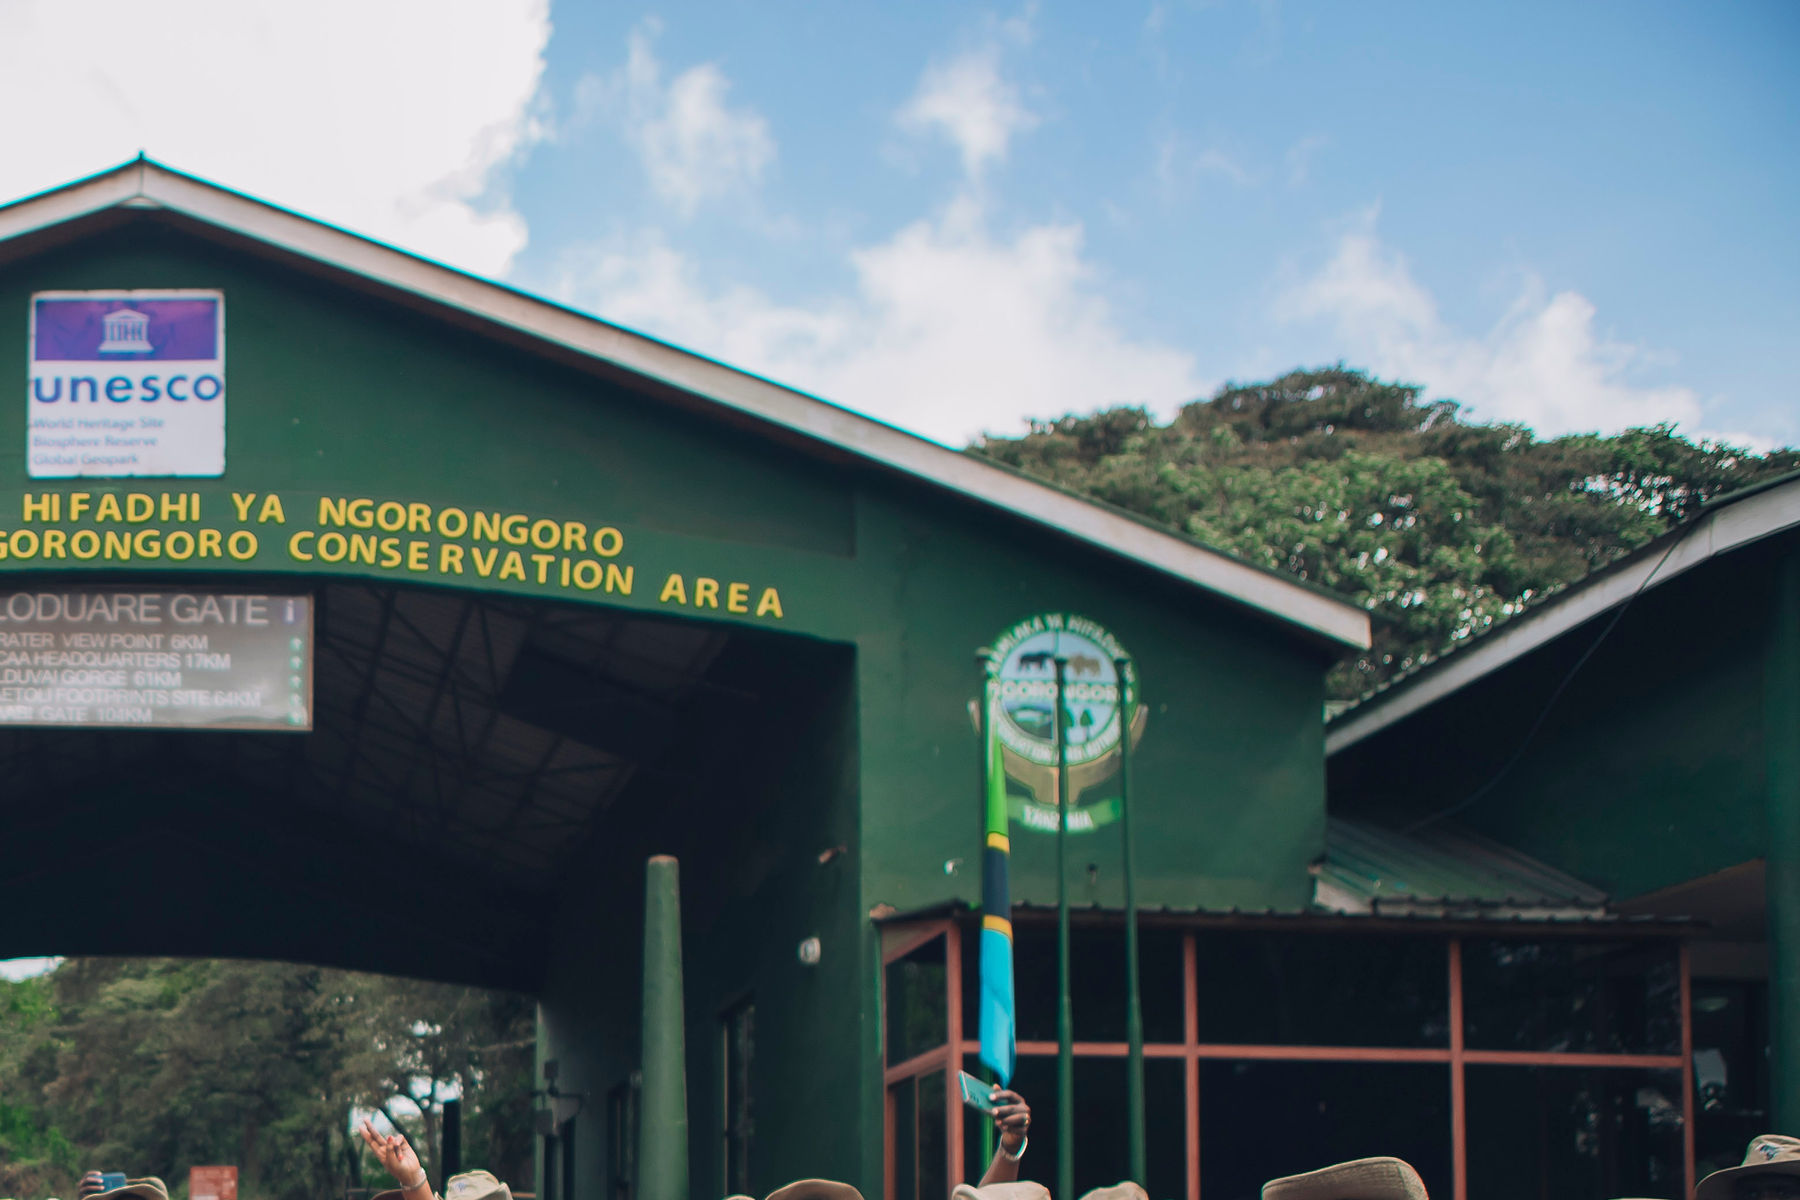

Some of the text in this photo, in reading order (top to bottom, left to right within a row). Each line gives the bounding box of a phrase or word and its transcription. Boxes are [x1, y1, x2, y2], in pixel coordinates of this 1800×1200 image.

[34, 374, 223, 404] unesco
[33, 416, 165, 432] World Heritage Site
[33, 436, 159, 449] Biosphere Reserve
[22, 492, 200, 522] HIFADHI
[232, 493, 286, 524] YA
[318, 496, 624, 558] NGORONGORO
[288, 530, 634, 596] CONSERVATION
[659, 573, 784, 619] AREA
[169, 593, 270, 624] GATE
[170, 635, 209, 650] 6KM
[33, 652, 181, 669] HEADQUARTERS
[185, 654, 231, 670] 17KM
[61, 670, 128, 687] GORGE
[56, 689, 170, 706] FOOTPRINTS
[173, 690, 210, 706] SITE
[41, 706, 88, 722] GATE
